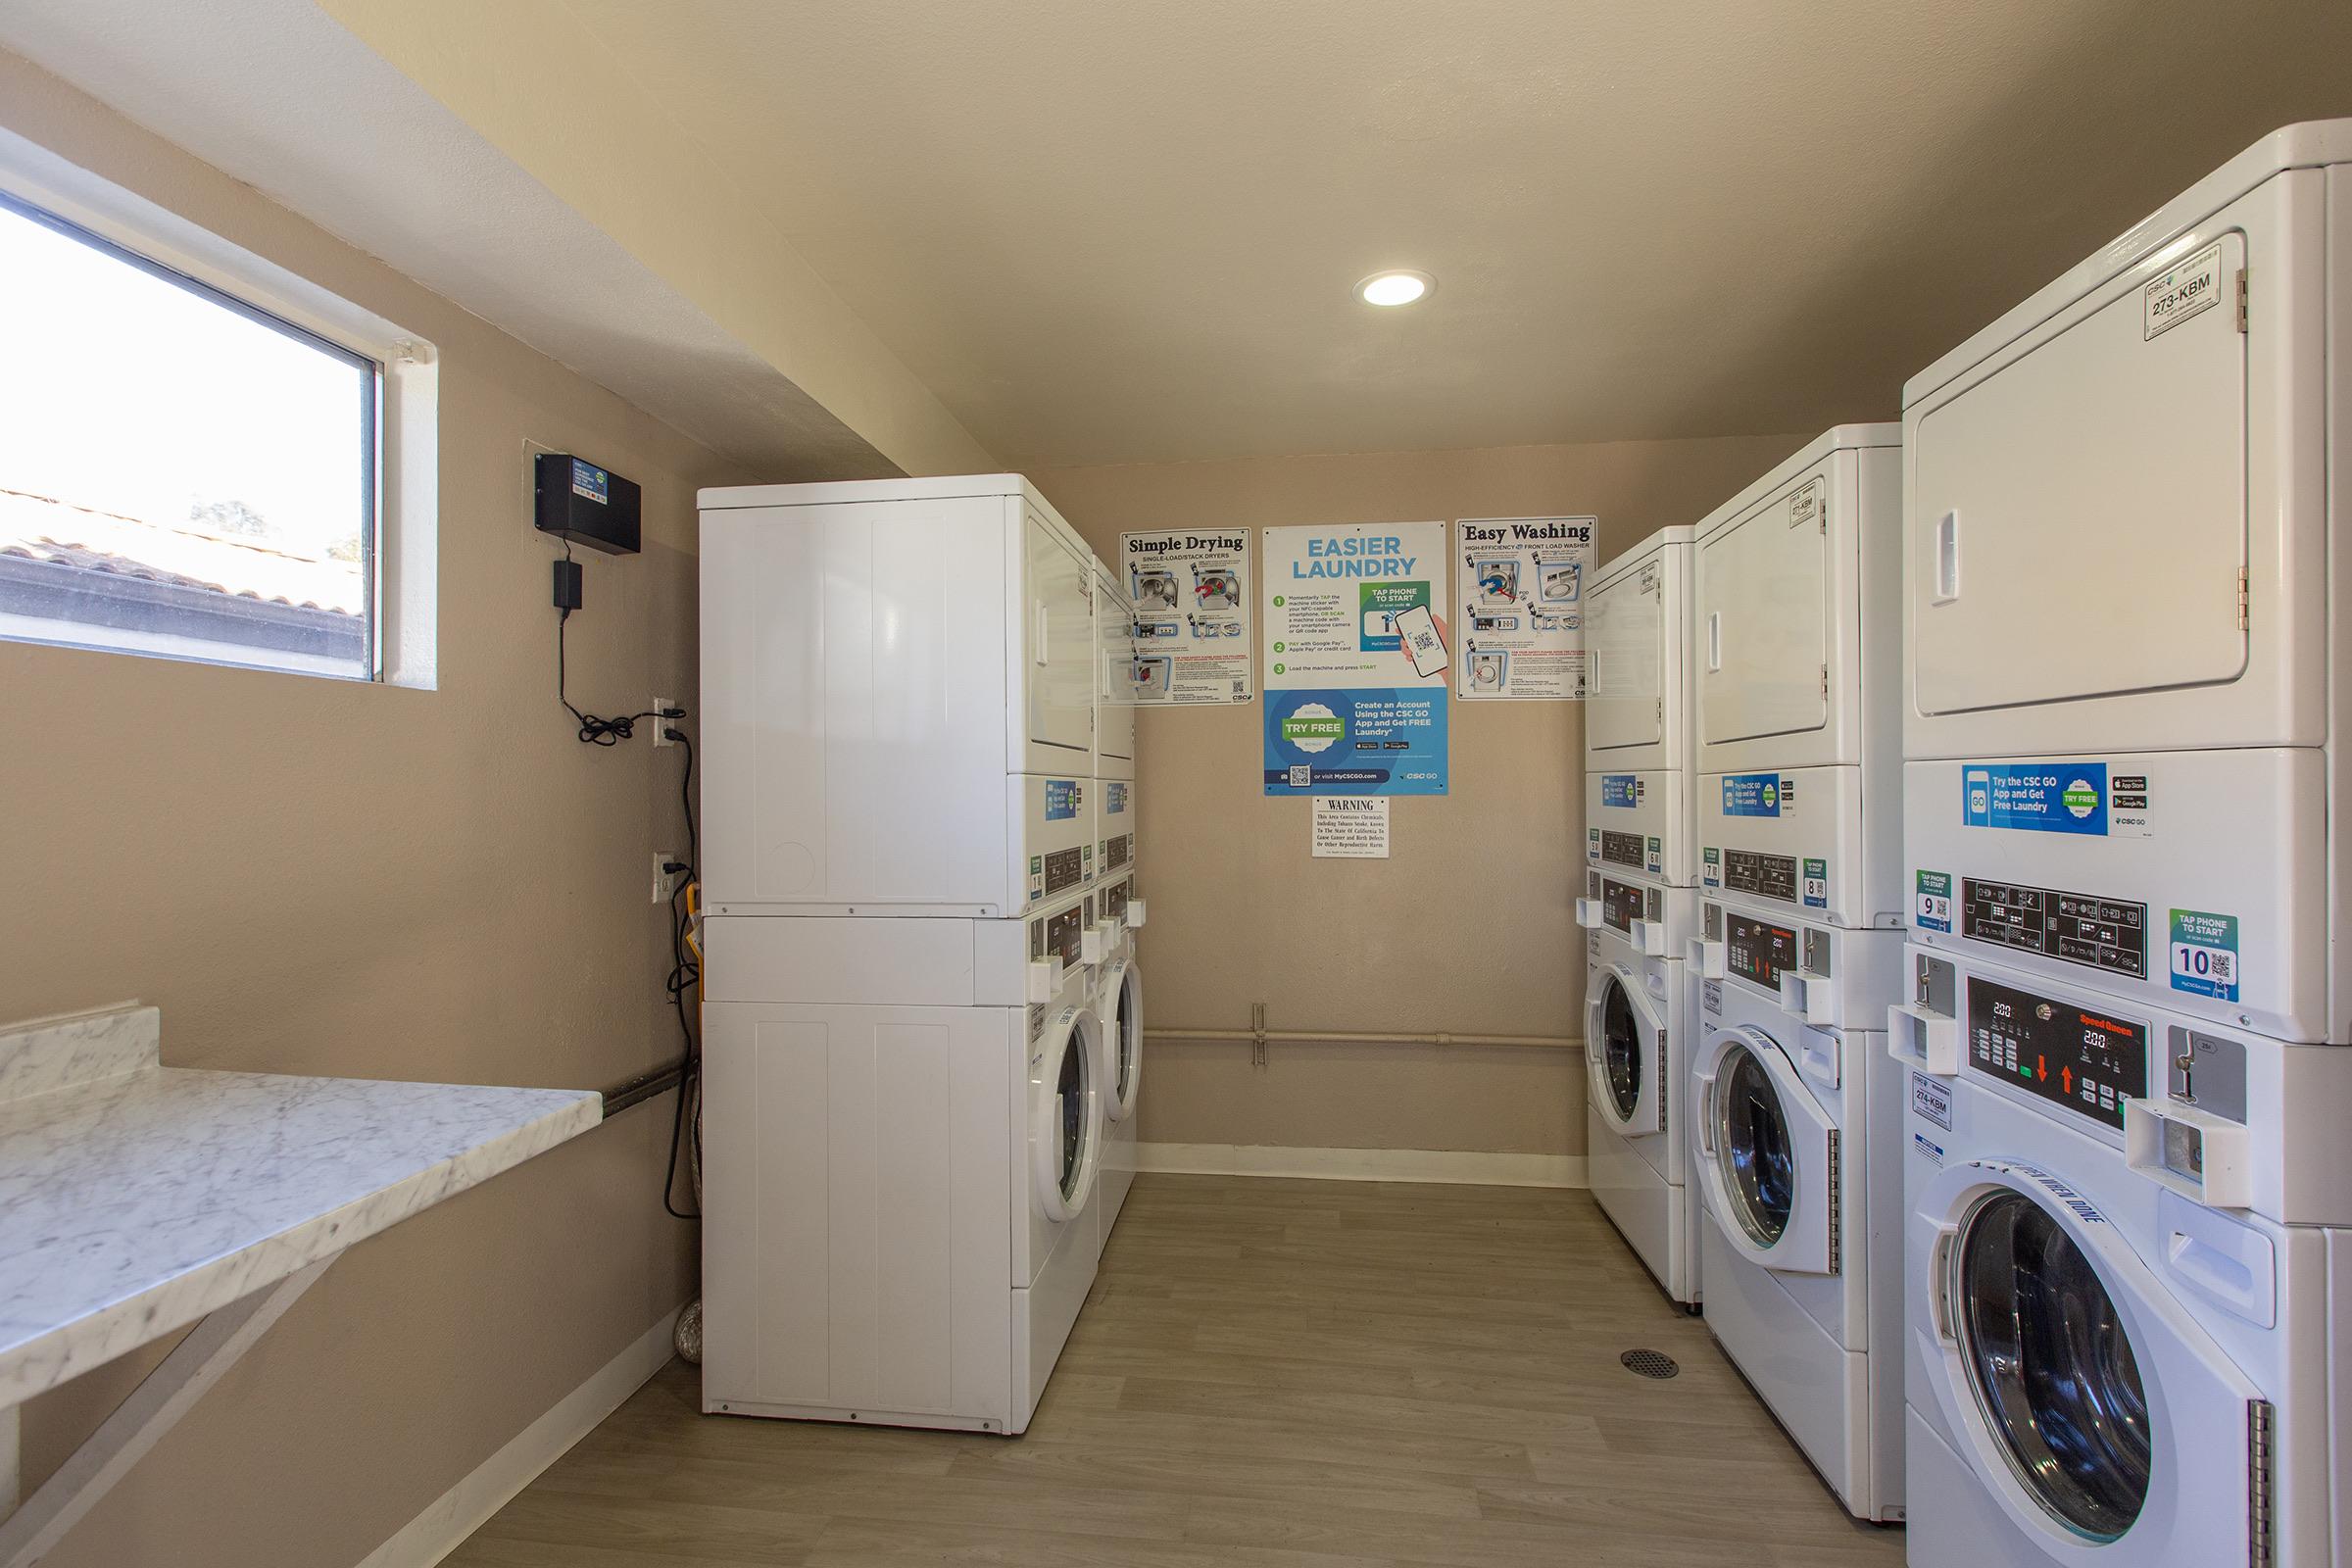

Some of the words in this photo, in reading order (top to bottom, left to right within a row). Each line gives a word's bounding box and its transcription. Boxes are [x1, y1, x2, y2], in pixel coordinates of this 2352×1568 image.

[2148, 281, 2166, 295] CSC
[2153, 273, 2210, 316] 273-KBM
[1465, 525, 1507, 545] Easy
[1510, 522, 1591, 542] Washing
[1129, 537, 1182, 555] Simple
[1185, 536, 1244, 552] Drying
[1308, 537, 1401, 557] EASIER
[1143, 554, 1202, 563] SINGLE-LOAD/STACK
[1294, 558, 1417, 578] LAUNDRY
[1311, 723, 1341, 732] FREE
[1992, 777, 2006, 787] Try
[2008, 777, 2021, 786] the
[2023, 777, 2040, 786] CSC
[2042, 777, 2057, 787] GO
[1993, 789, 2010, 799] App
[2012, 789, 2027, 799] and
[2029, 789, 2044, 799] Get
[1328, 800, 1374, 810] WARNING
[1973, 797, 1984, 807] GO
[1993, 801, 2011, 809] Free
[2013, 801, 2047, 813] Laundry
[1809, 880, 1814, 894] 8
[1925, 898, 1933, 914] 9
[2197, 917, 2228, 929] PHONE
[2196, 926, 2224, 937] START
[2180, 948, 2209, 975] 10
[2080, 1013, 2106, 1029] Speed
[2106, 1020, 2132, 1037] Queen
[1916, 1090, 1946, 1113] 274-KBM
[2038, 1178, 2079, 1198] WHEN
[2066, 1200, 2105, 1224] DONE
